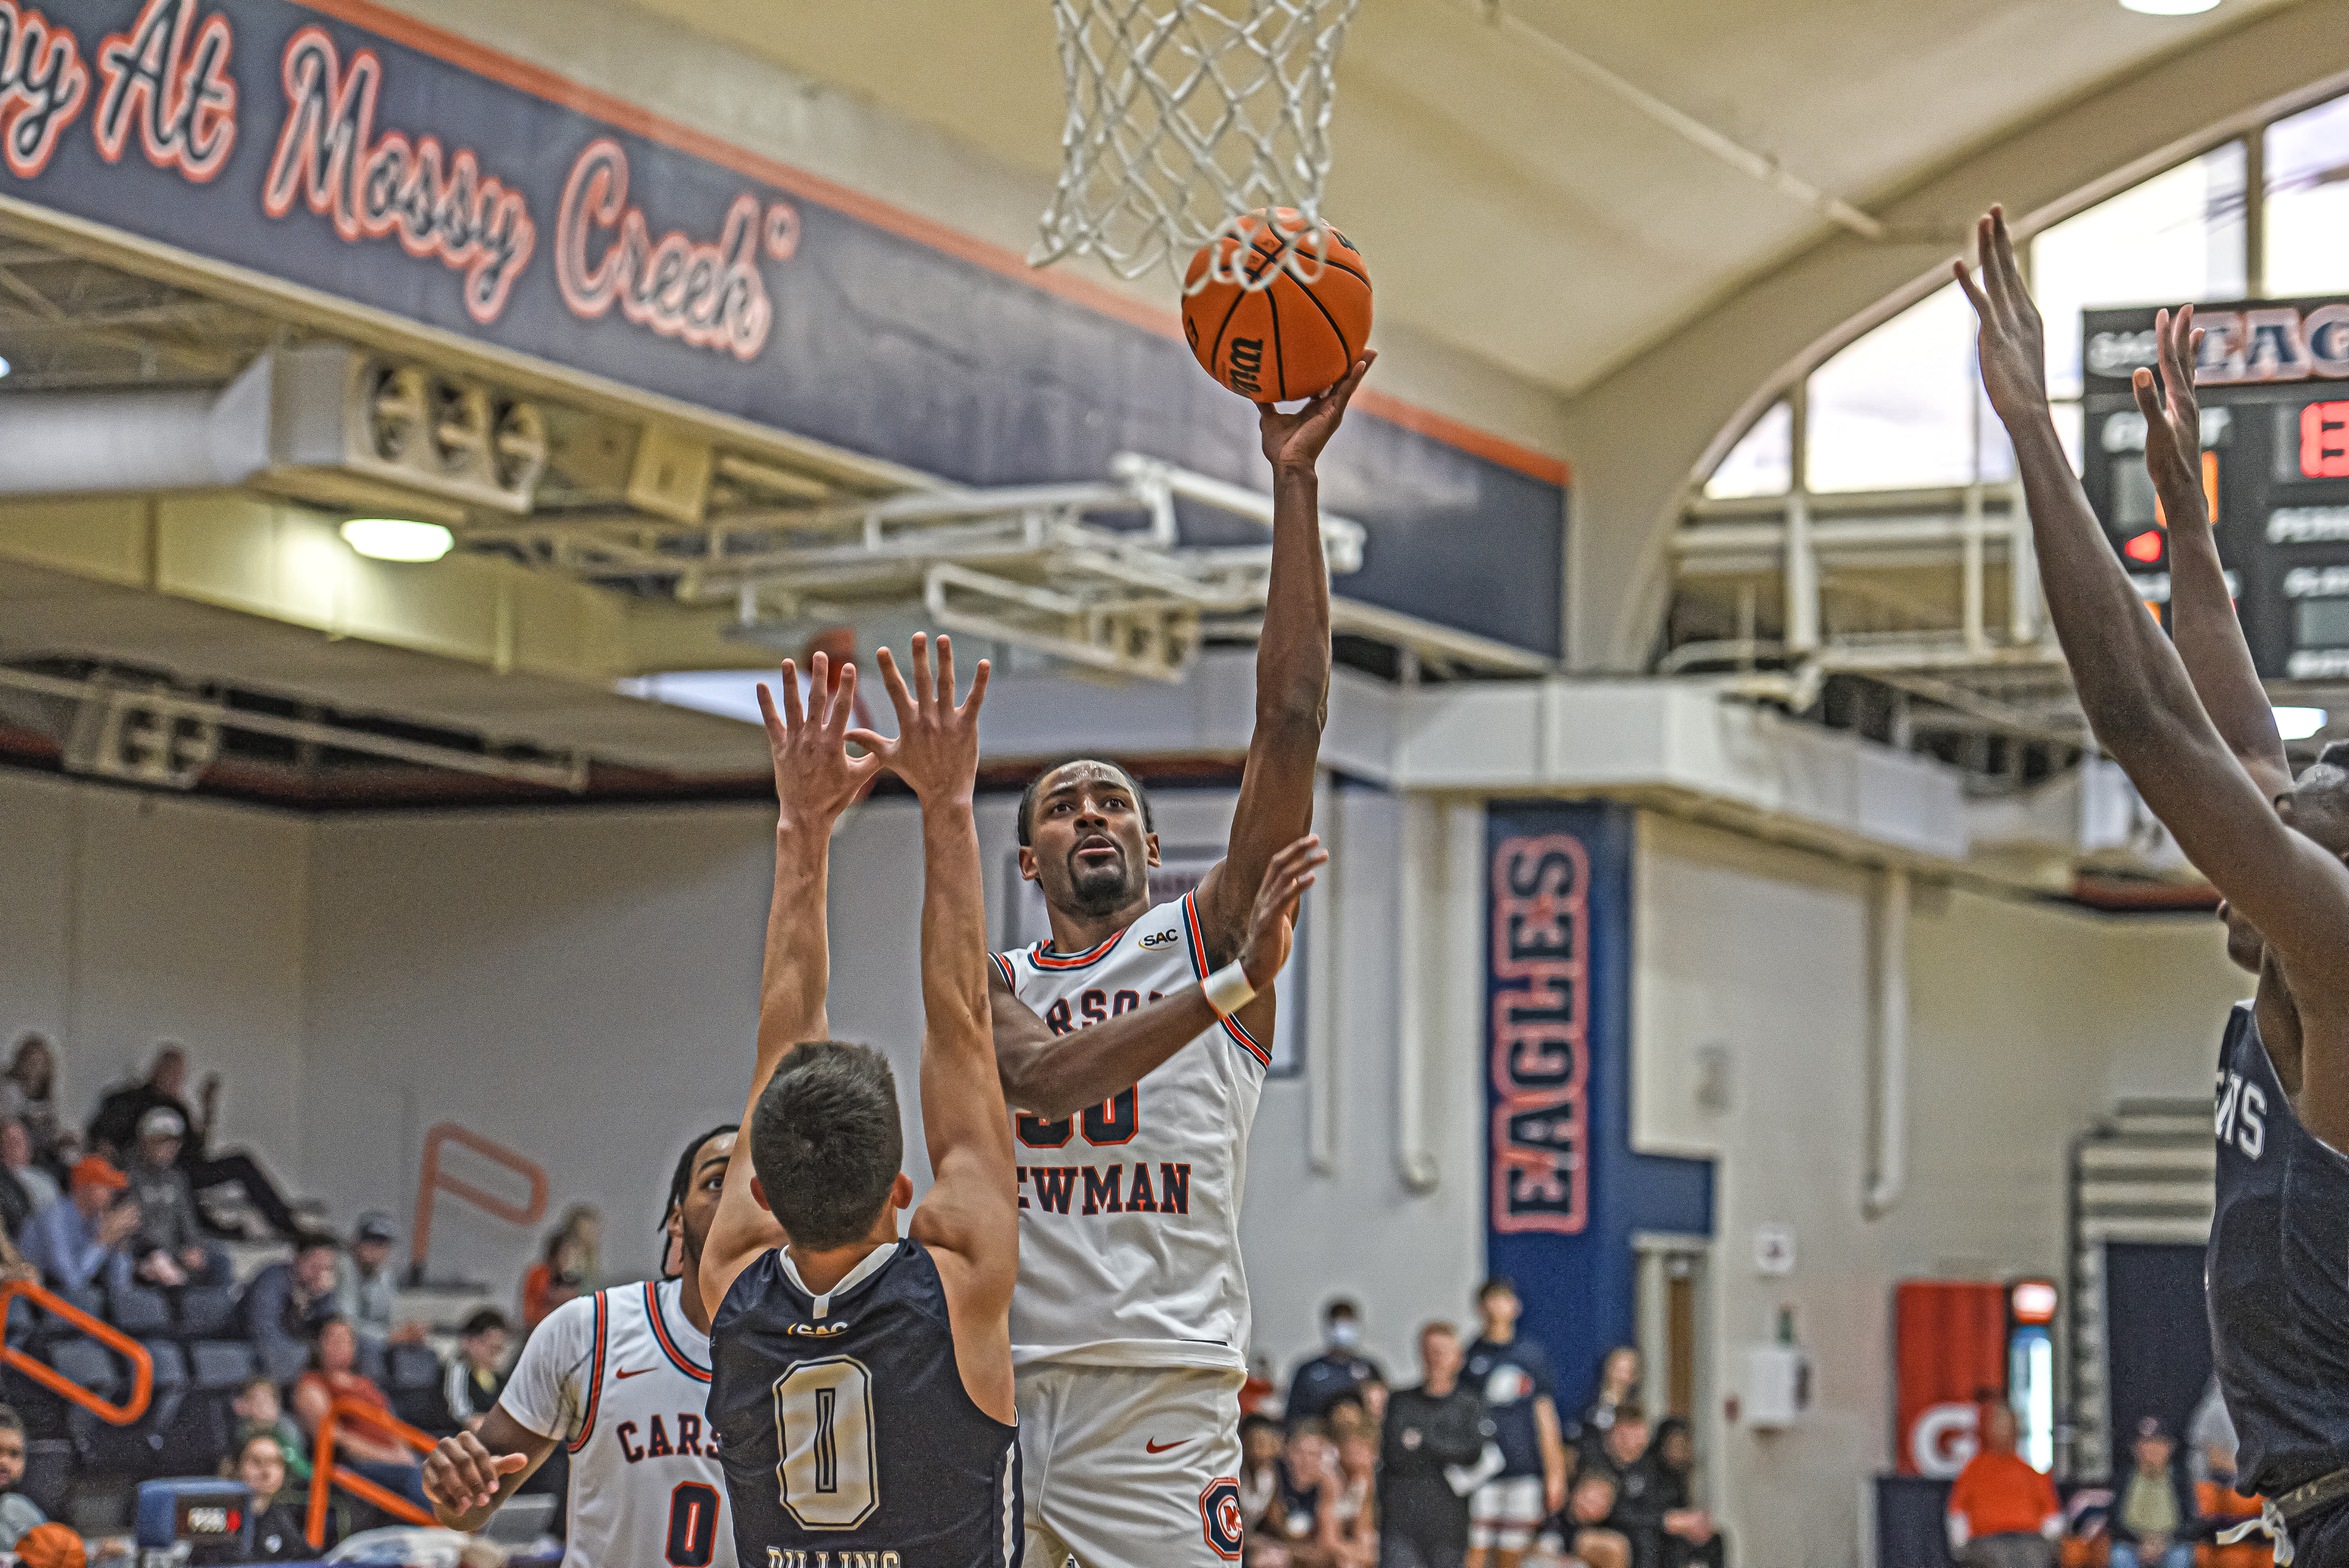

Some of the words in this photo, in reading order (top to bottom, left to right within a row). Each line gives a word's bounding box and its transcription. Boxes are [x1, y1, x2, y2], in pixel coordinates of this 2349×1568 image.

[94, 0, 236, 182] At
[265, 27, 535, 322] Mossy
[556, 138, 774, 360] Creek
[1143, 928, 1178, 947] SAC
[1044, 988, 1166, 1037] RSO
[1499, 840, 1581, 1227] EAGLES
[773, 1355, 879, 1531] 0
[665, 1480, 721, 1568] 0
